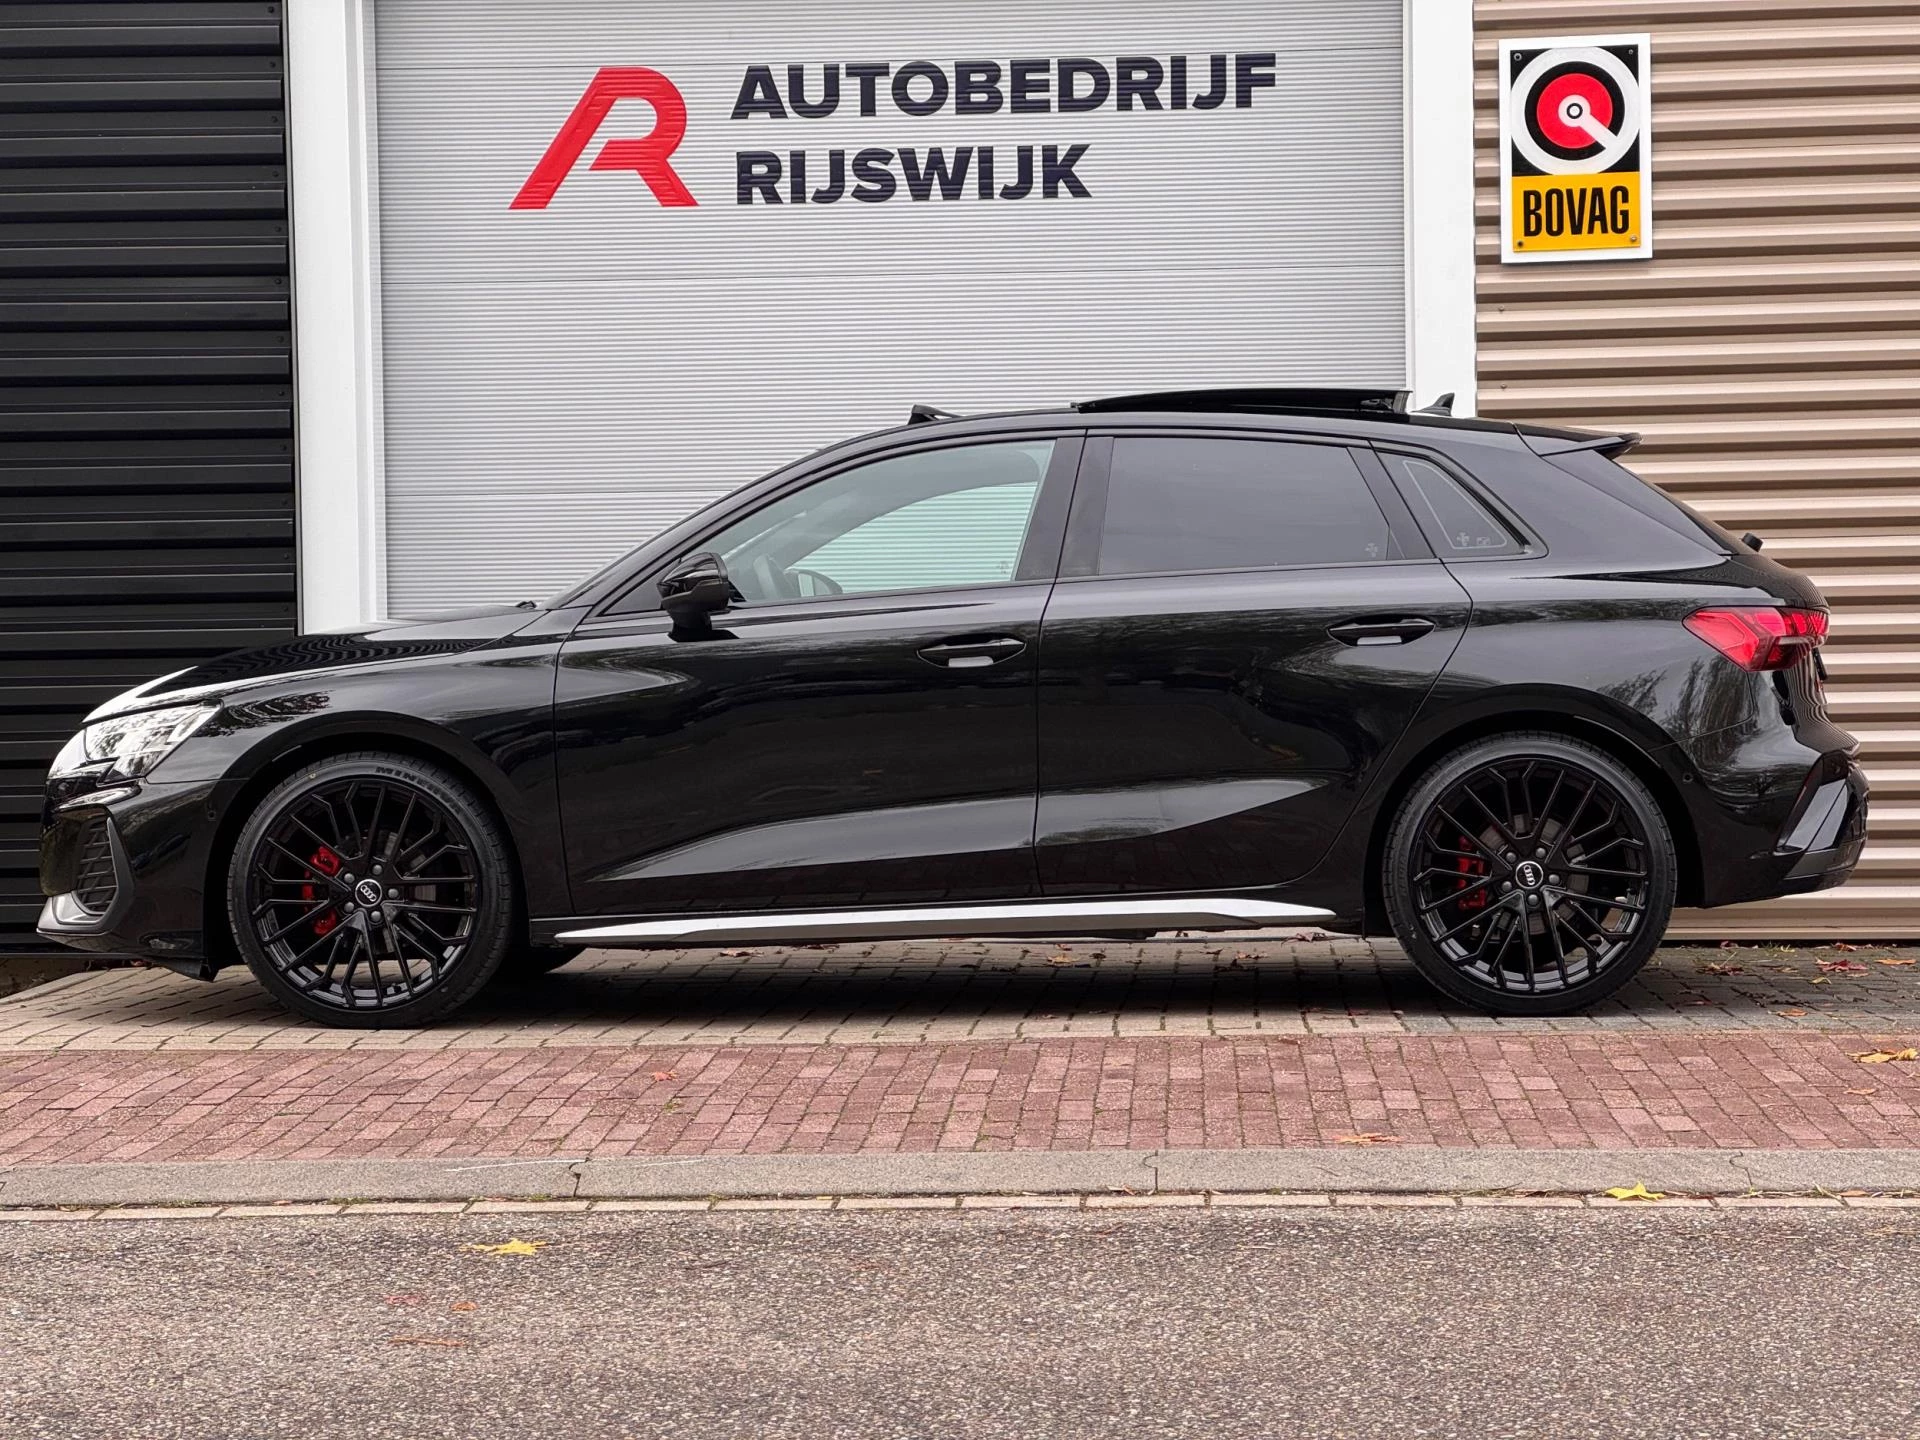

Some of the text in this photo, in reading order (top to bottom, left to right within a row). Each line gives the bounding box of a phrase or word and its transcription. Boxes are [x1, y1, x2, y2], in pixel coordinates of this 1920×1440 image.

[731, 53, 1276, 119] AUTOBEDRIJF
[736, 144, 1092, 205] RIJSWIJK
[1523, 185, 1630, 237] BOVAG
